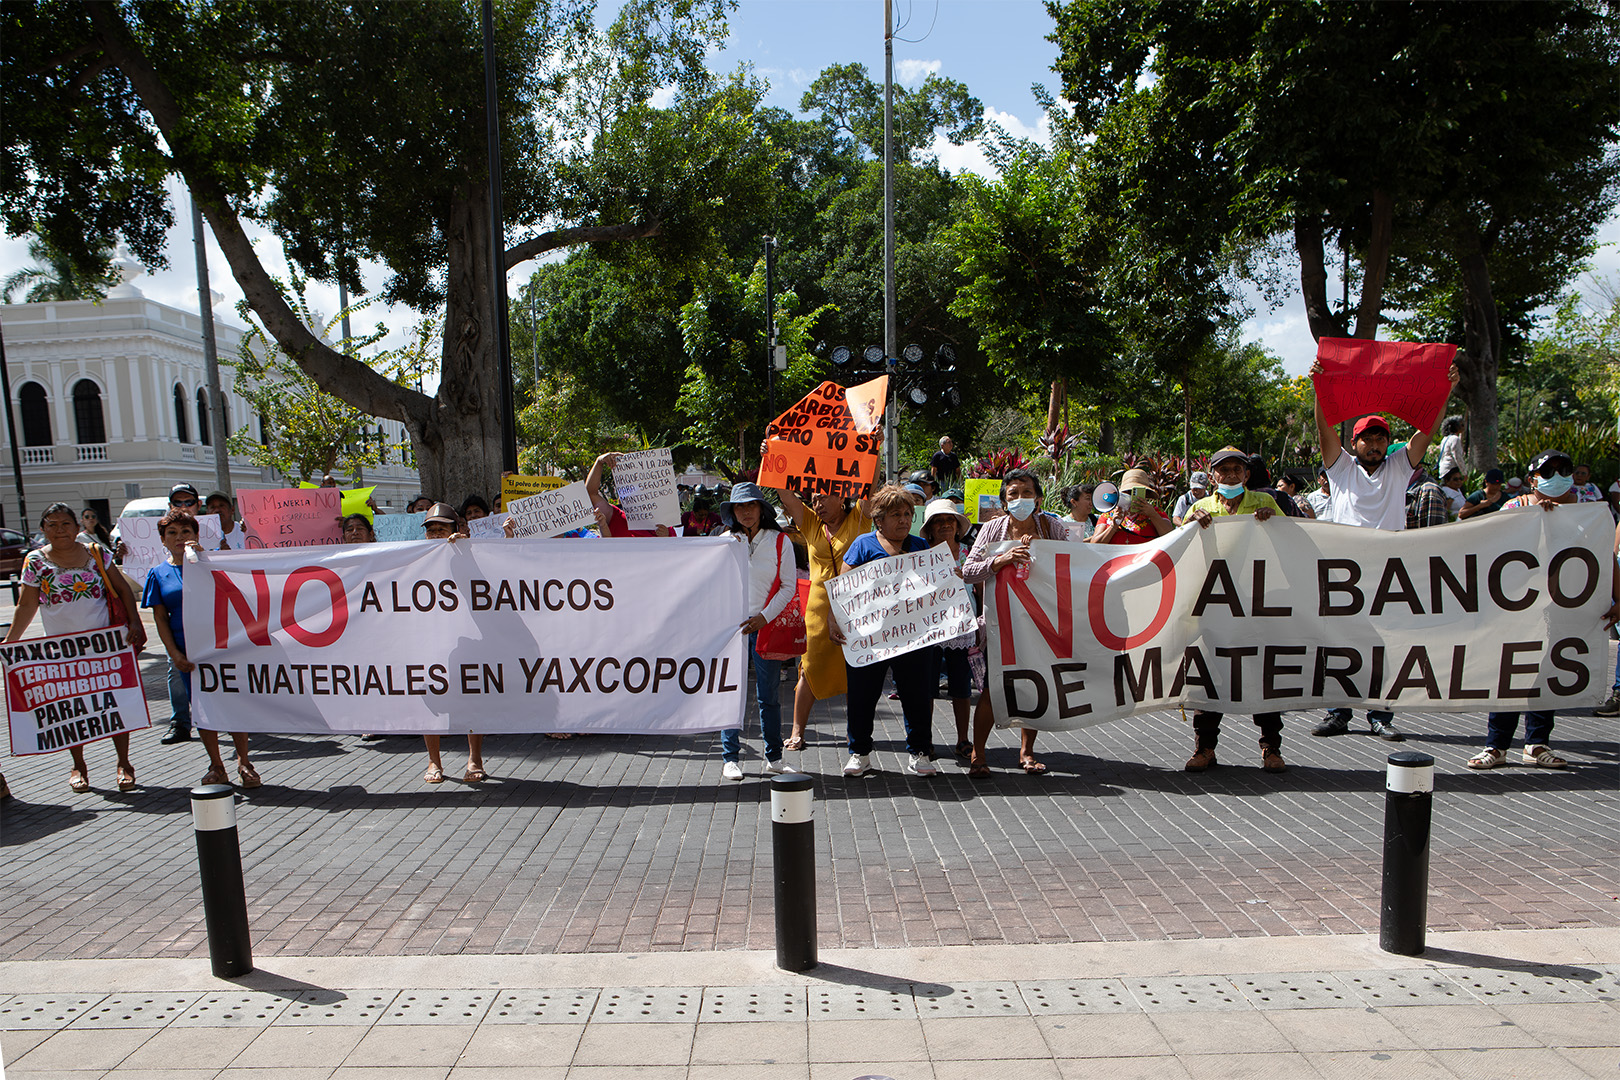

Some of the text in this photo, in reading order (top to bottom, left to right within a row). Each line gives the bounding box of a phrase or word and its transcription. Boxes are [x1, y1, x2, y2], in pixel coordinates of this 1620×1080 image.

[779, 412, 810, 428] NO
[1365, 392, 1440, 430] DERECHO
[768, 424, 813, 446] PERO
[826, 431, 848, 451] YO
[660, 448, 670, 457] LA
[638, 461, 644, 470] Y
[646, 460, 656, 469] LA
[762, 454, 860, 477] NO A LA
[515, 480, 531, 488] polvo
[541, 481, 551, 489] hoy
[620, 488, 673, 505] MANTENIENDO
[638, 479, 671, 491] SEGUIR
[785, 475, 872, 500] MINERIA
[263, 494, 311, 512] MINERIA
[315, 491, 337, 509] NO
[509, 491, 564, 515] QUEREMOS
[556, 504, 571, 516] NO
[573, 499, 585, 511] AL
[280, 525, 294, 534] ES
[514, 525, 539, 538] BANCO
[540, 522, 552, 533] DE
[908, 554, 926, 570] TE
[905, 578, 915, 591] A
[210, 565, 615, 649] NO A LOS BANCOS
[844, 604, 900, 634] TARNOS
[905, 597, 924, 614] EN
[995, 546, 1600, 666] NO AL BANCO
[851, 601, 971, 652] CUL PARA VER LAS
[0, 630, 128, 666] YAXCOPOIL
[14, 656, 122, 688] TERRITORIO
[199, 656, 738, 696] DE MATERIALES EN YAXCOPOIL
[1002, 637, 1591, 720] DE MATERIALES
[23, 672, 123, 708] PROHIBIDO
[34, 691, 118, 729] PARA LA
[36, 709, 125, 751] MINERÍA
